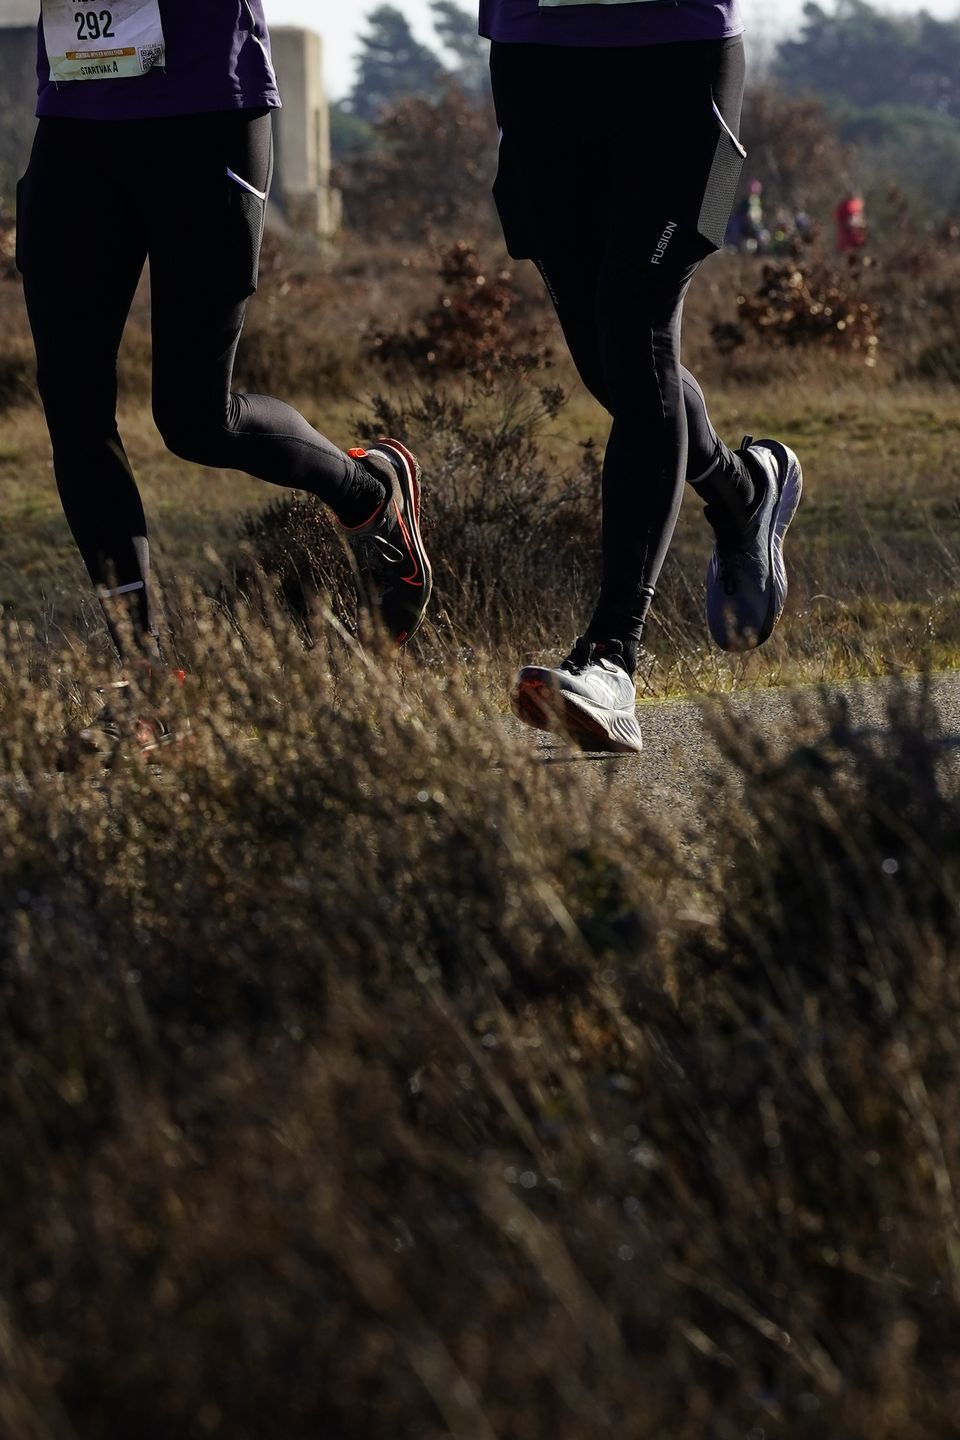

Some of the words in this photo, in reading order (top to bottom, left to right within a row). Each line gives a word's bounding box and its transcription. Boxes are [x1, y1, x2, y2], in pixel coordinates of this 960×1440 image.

[74, 10, 115, 41] 292
[80, 63, 113, 75] STARTVAK
[112, 61, 119, 73] A
[650, 220, 678, 265] FUSION
